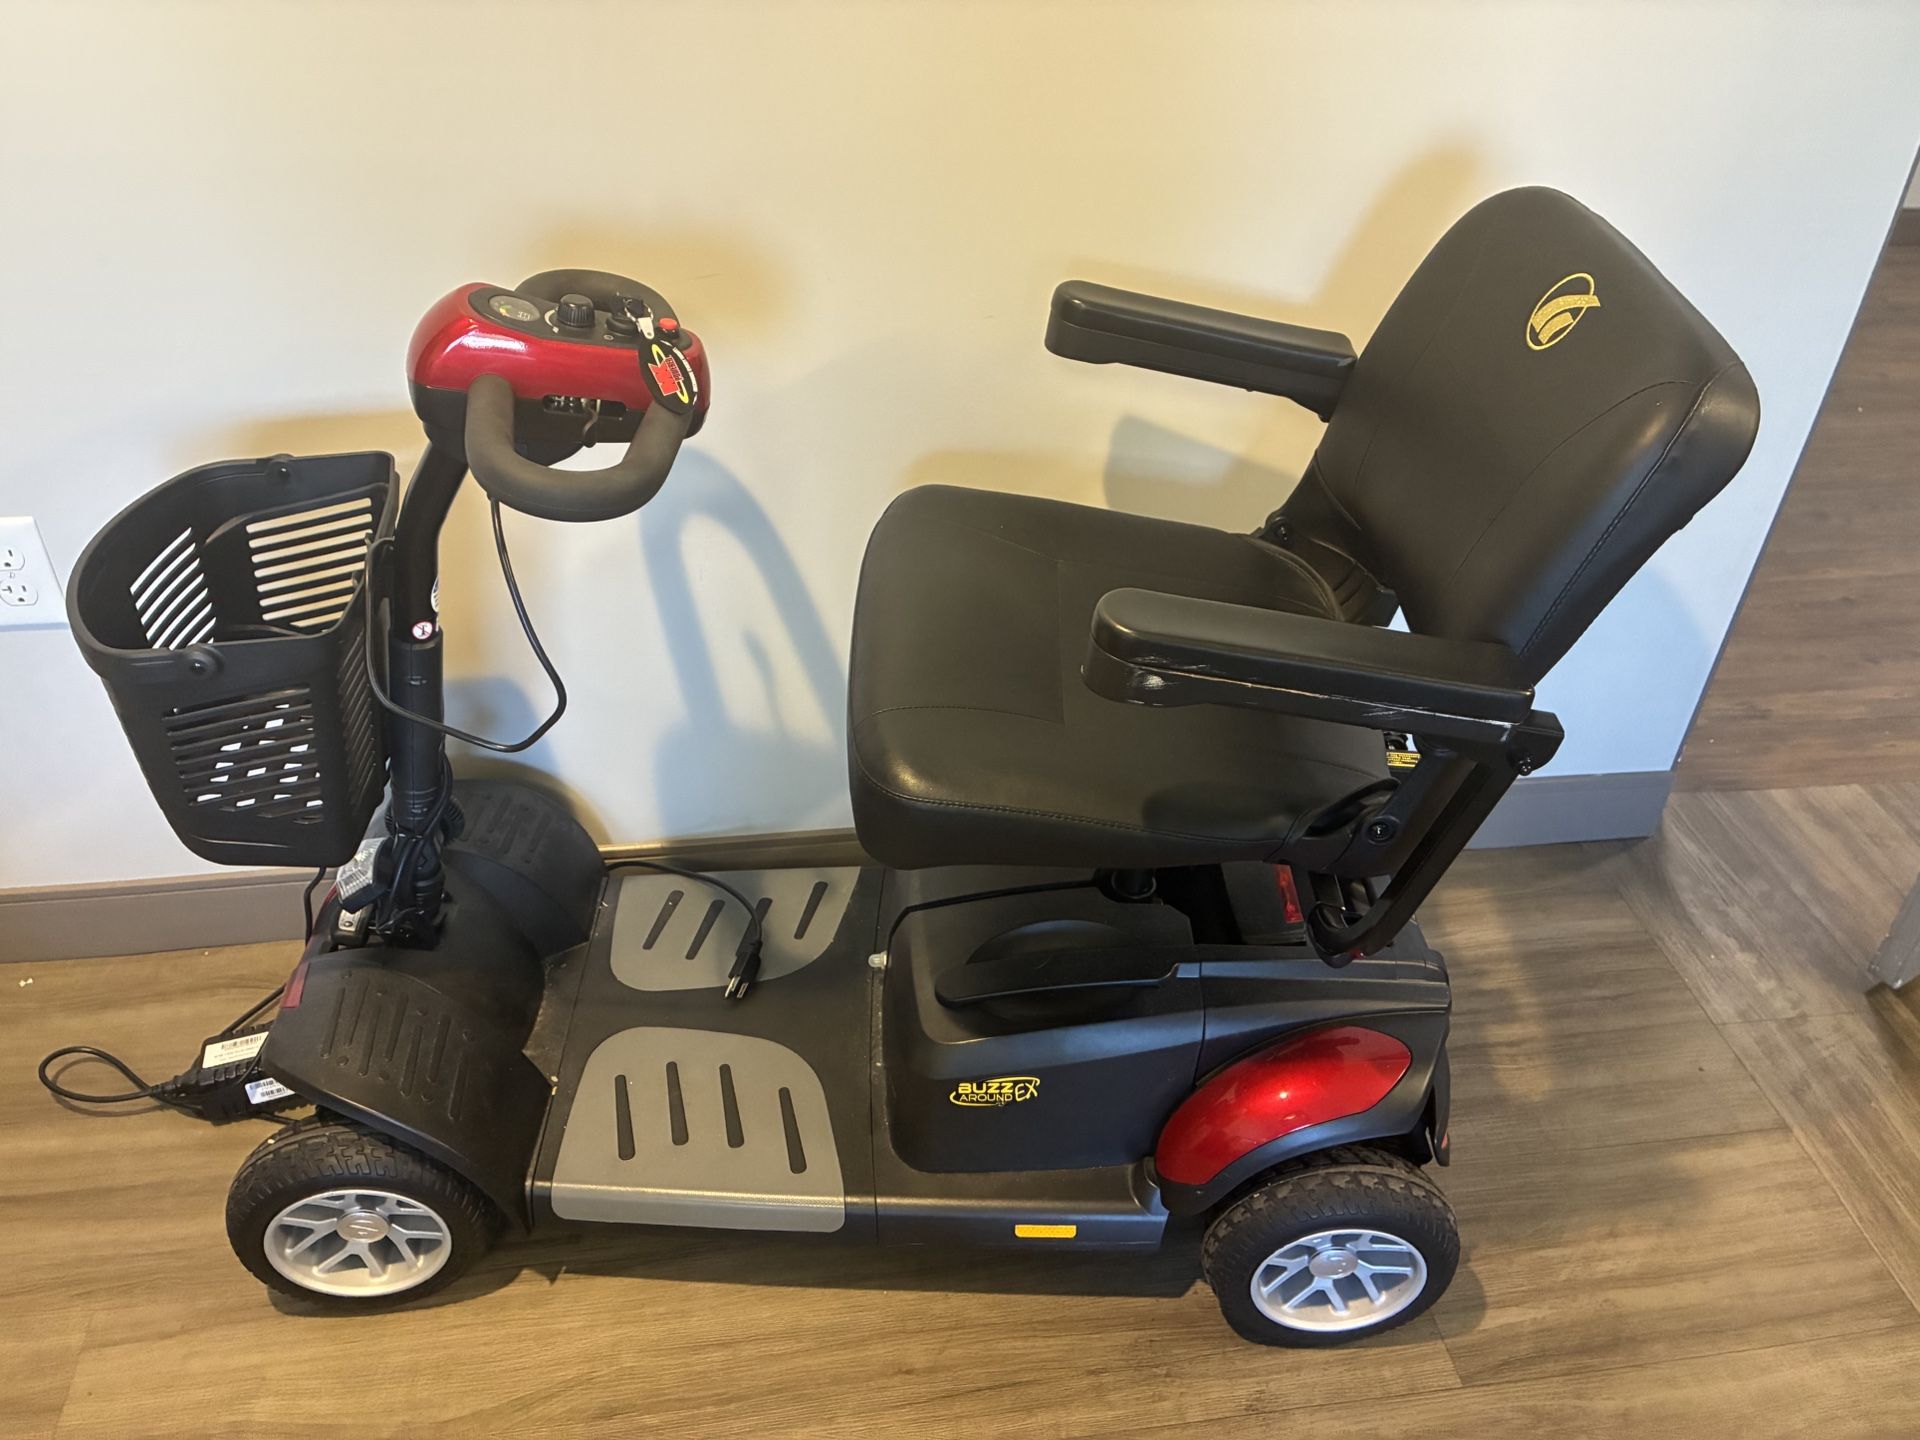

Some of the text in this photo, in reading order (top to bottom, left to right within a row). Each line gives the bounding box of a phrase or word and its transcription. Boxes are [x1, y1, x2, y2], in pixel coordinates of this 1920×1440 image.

[958, 1080, 1038, 1102] BUZZ EX
[959, 1094, 1013, 1102] AROUND
